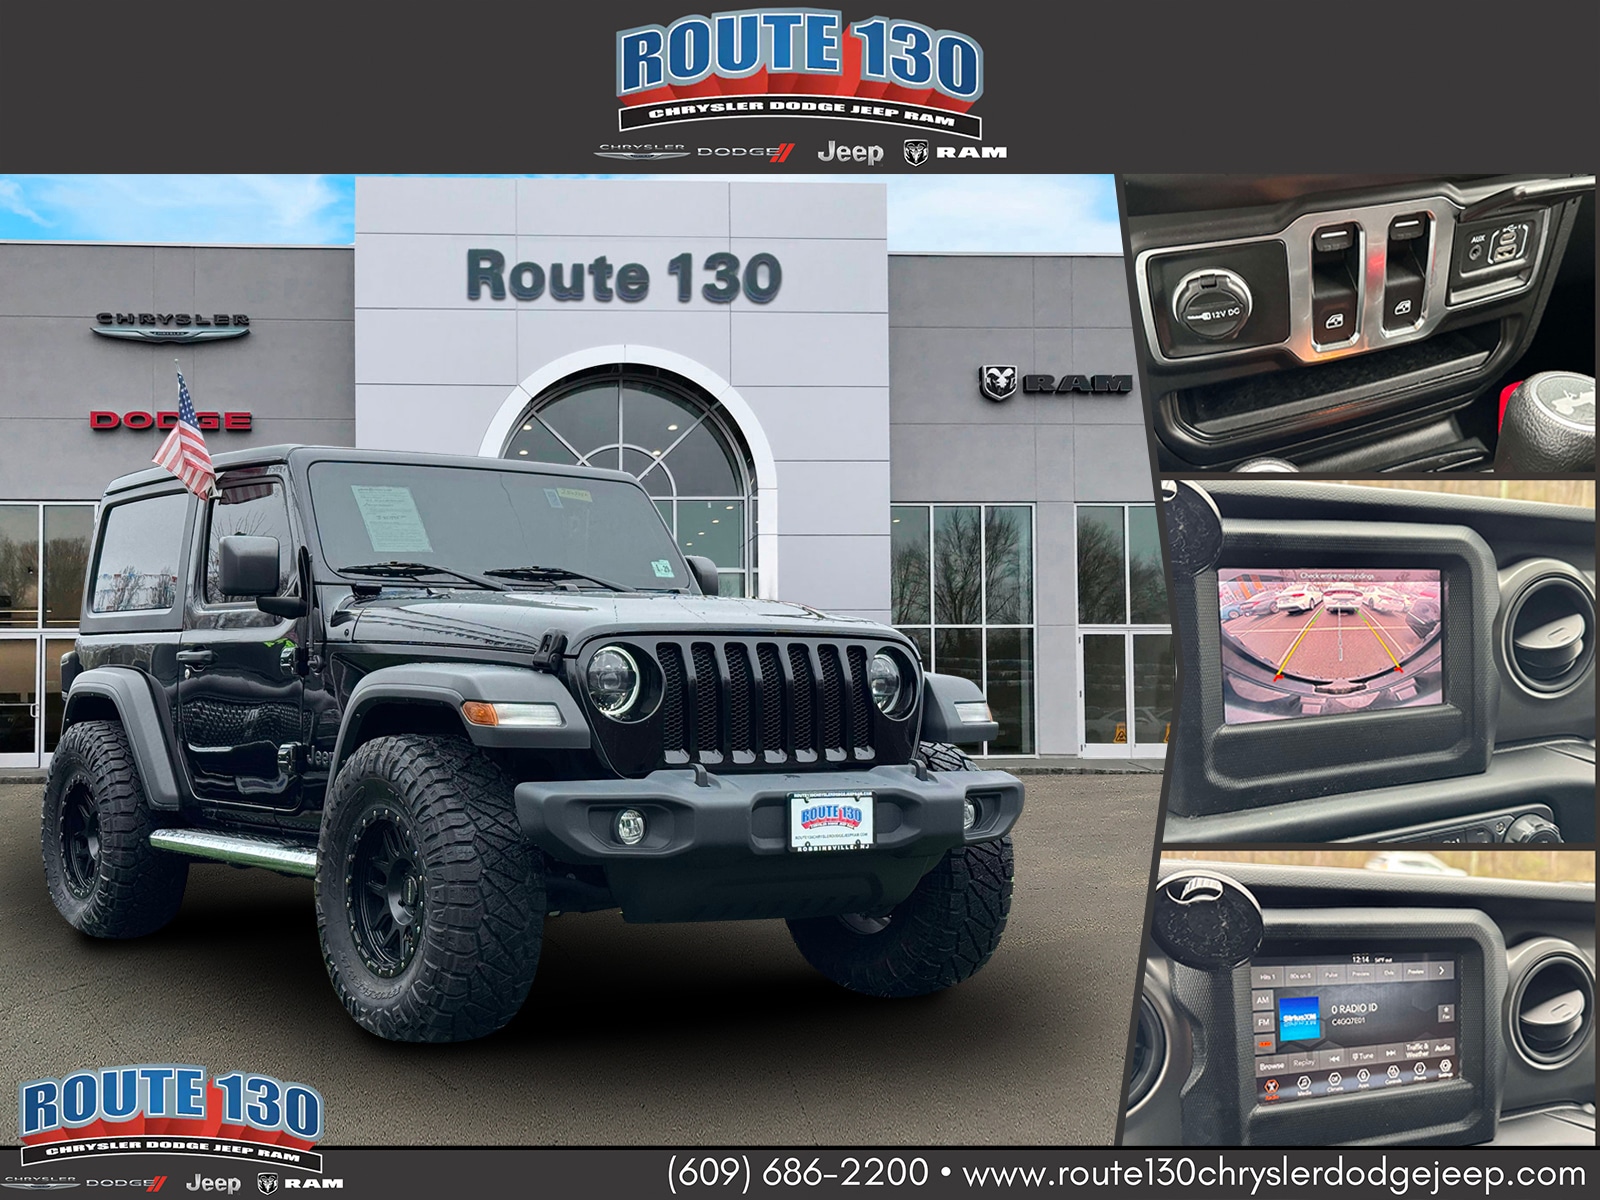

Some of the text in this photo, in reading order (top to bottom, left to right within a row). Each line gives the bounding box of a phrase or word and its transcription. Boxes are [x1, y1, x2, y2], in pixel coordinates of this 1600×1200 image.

[1471, 234, 1486, 244] AUX
[467, 248, 783, 304] Route 130
[1211, 306, 1241, 319] 12V DC
[96, 312, 250, 326] CHRYSLER
[1023, 374, 1133, 393] RAM
[90, 410, 252, 430] DODGE
[1299, 571, 1375, 581] Check entire surroundings
[801, 804, 863, 823] ROUTE 130
[1352, 955, 1370, 964] 12:14
[1256, 996, 1270, 1004] AM
[1339, 1004, 1367, 1014] RADIO
[1368, 1003, 1378, 1012] ID
[1258, 1018, 1270, 1026] FM
[1283, 1012, 1317, 1022] SiriusXM
[1434, 1044, 1452, 1052] Audio
[1359, 1052, 1374, 1060] Tune
[1405, 1050, 1430, 1058] Weather
[1259, 1061, 1285, 1071] Browse
[1293, 1058, 1316, 1068] Replay
